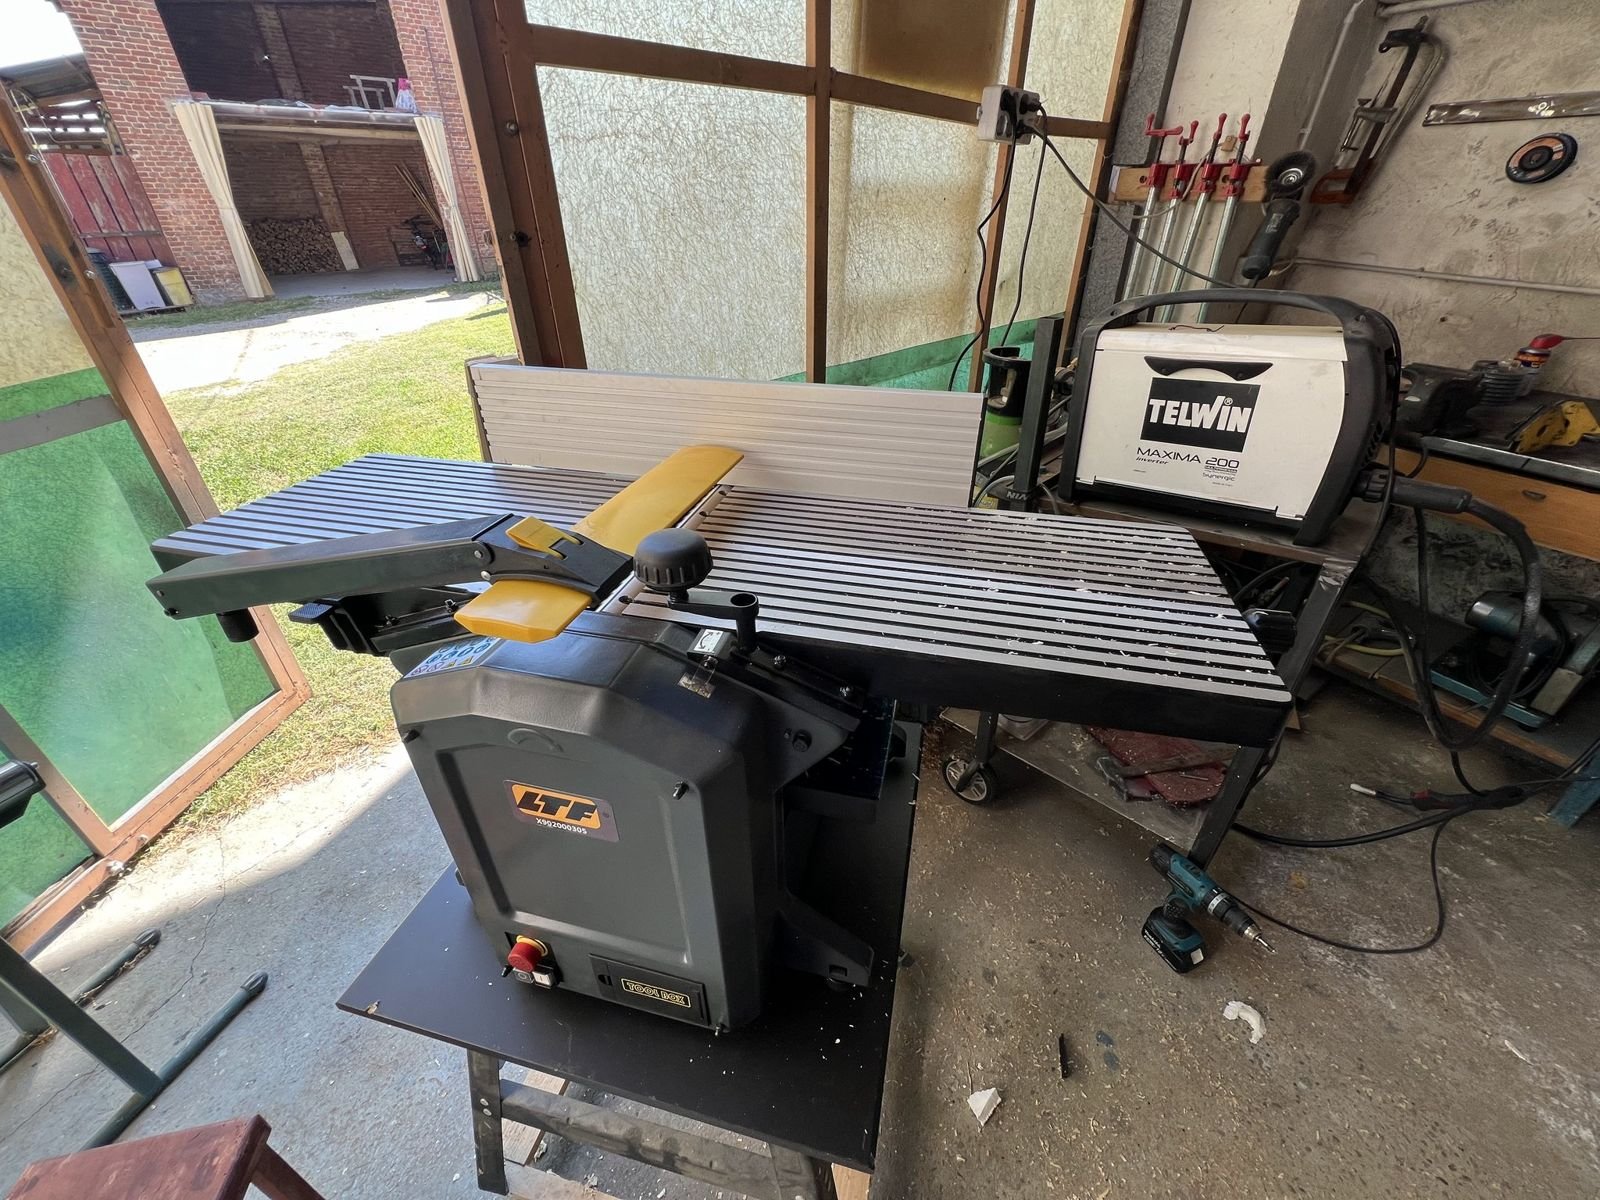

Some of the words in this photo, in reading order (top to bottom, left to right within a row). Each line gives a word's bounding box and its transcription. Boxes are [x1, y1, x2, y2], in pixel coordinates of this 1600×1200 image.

[1149, 396, 1252, 433] TELWIN
[1136, 447, 1201, 463] MAXIMA
[1205, 457, 1240, 469] 200
[516, 790, 598, 821] LTF
[536, 817, 588, 835] X902000305
[626, 981, 660, 998] TOOL
[660, 990, 686, 1005] BOX
